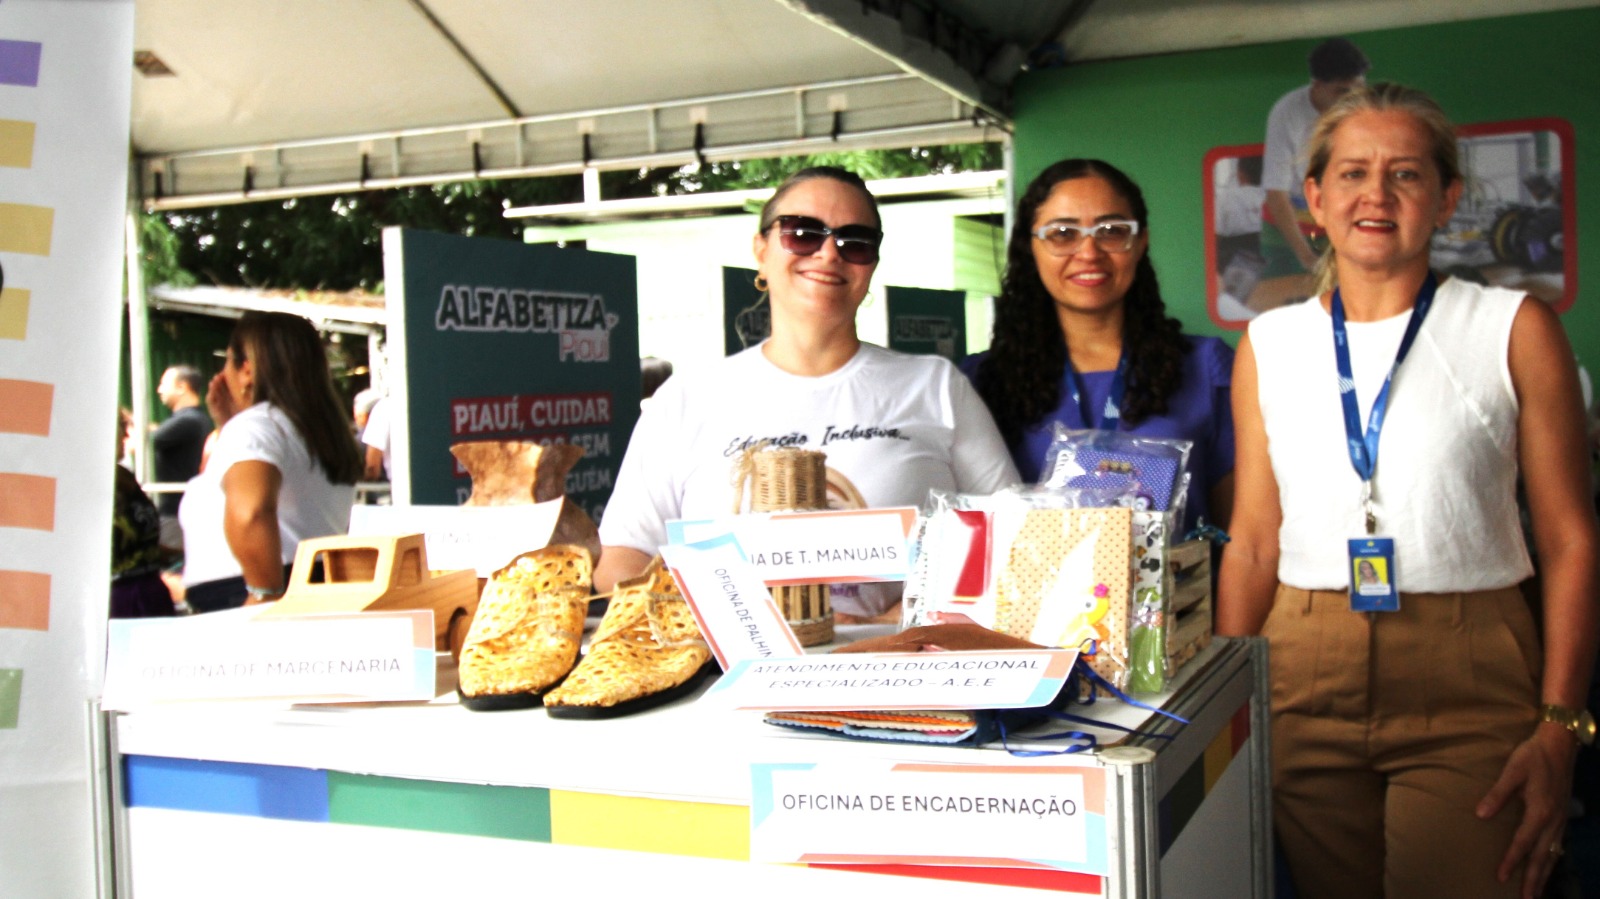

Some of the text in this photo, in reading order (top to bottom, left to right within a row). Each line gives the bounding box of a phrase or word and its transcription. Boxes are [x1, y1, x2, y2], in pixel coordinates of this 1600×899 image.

[437, 287, 607, 331] ALFABETIZA
[454, 396, 609, 432] PIAUÍ, CUIDAR
[564, 469, 612, 494] GUÉM
[772, 551, 794, 566] DE
[800, 550, 812, 565] T.
[817, 546, 897, 565] MANUAIS
[714, 568, 773, 658] OFICINA DE PALHIN
[266, 658, 401, 676] MARCENARIA
[754, 659, 1039, 675] ATENDIMENTO EDUCACIONAL
[769, 677, 923, 689] ESPECIALIZADO
[943, 677, 997, 689] A.E.E
[783, 794, 1076, 820] OFICINA DE ENCADERNAÇÃO
